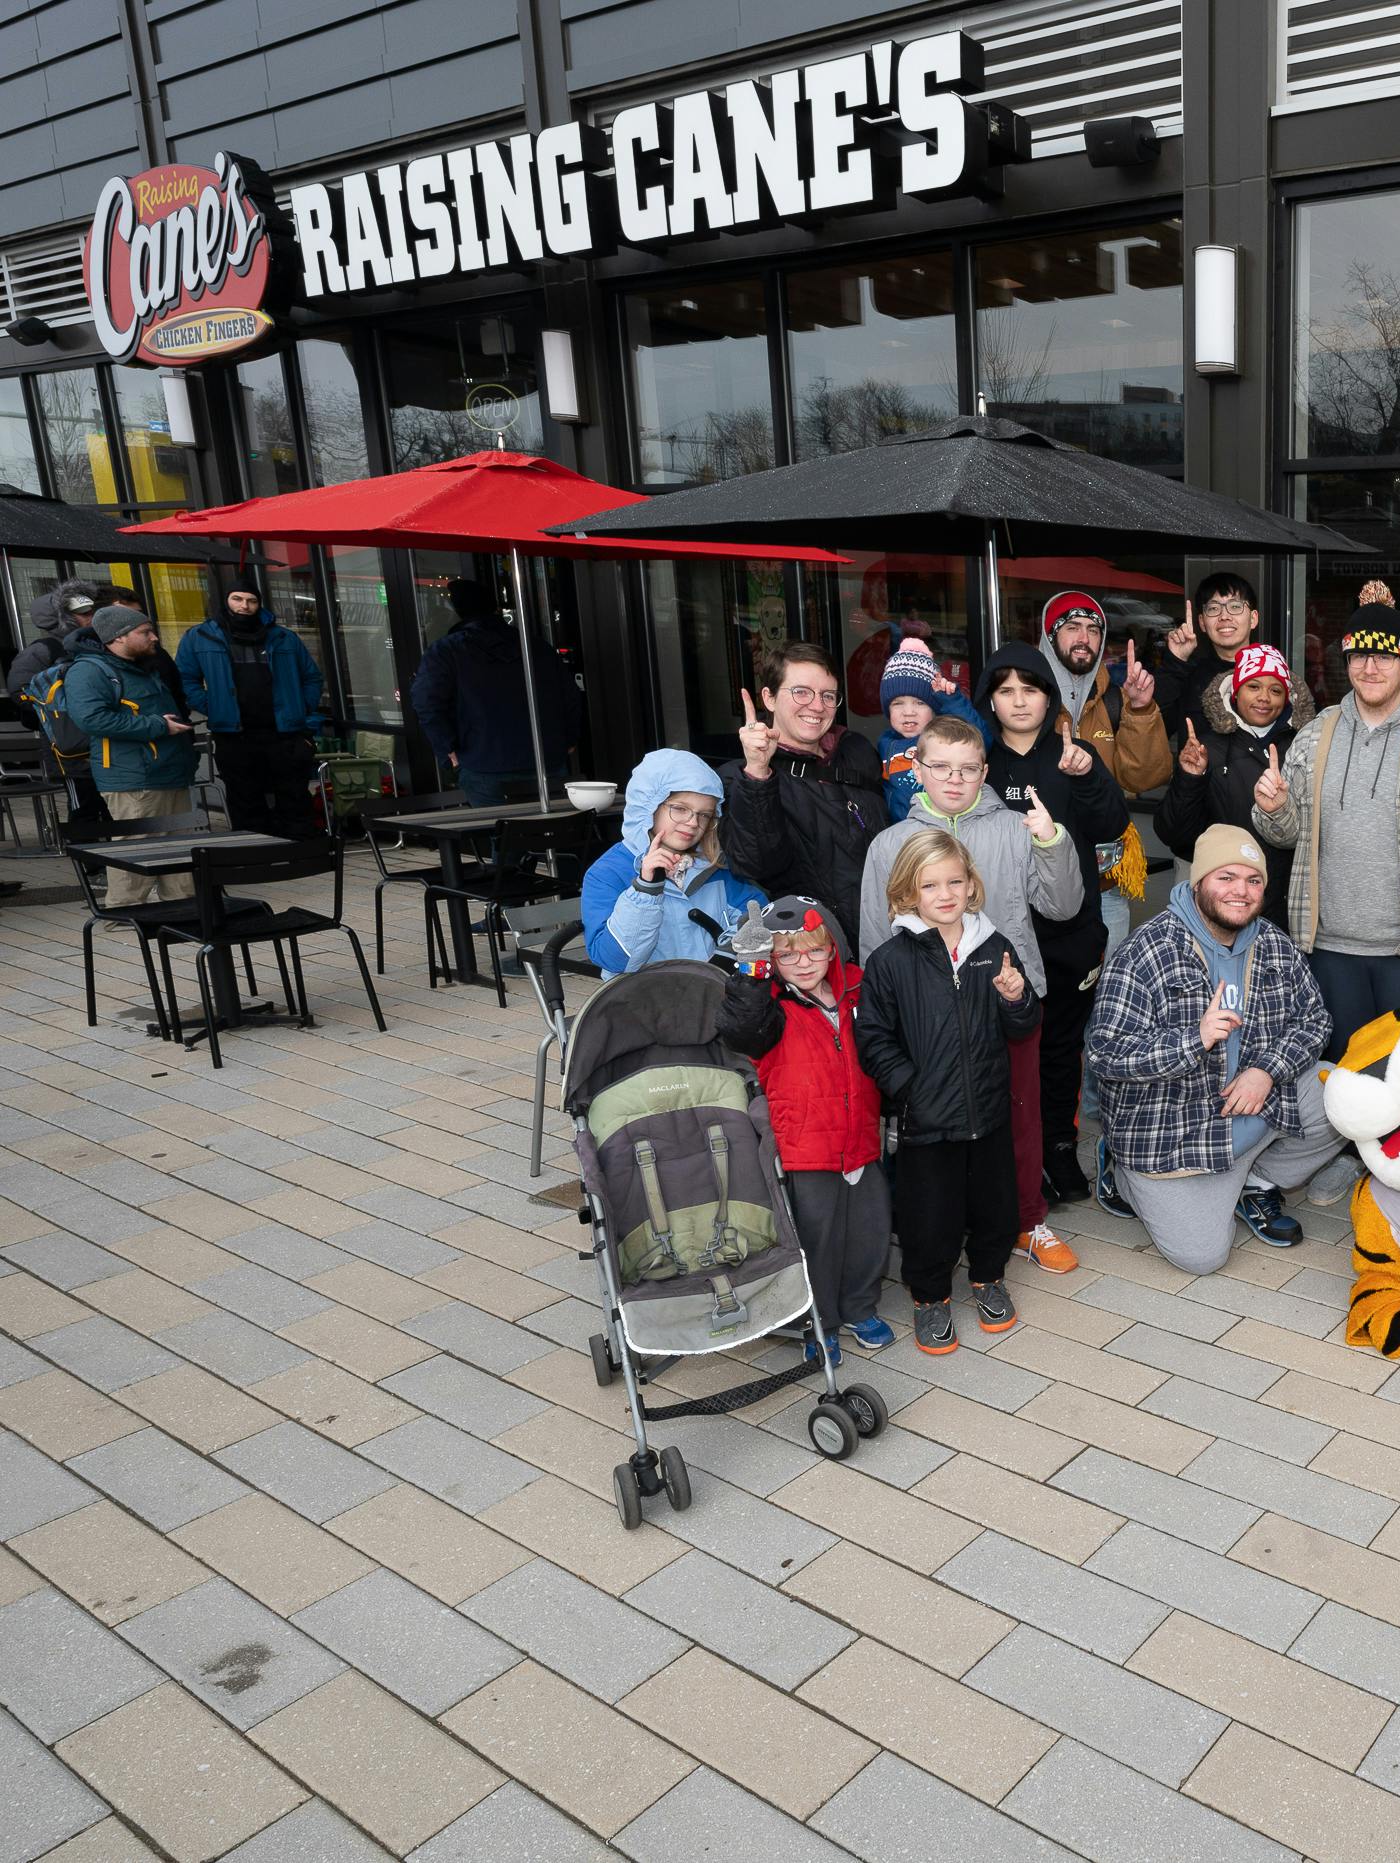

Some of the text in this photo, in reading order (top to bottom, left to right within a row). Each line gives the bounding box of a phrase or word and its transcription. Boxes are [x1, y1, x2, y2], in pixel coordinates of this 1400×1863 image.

[290, 30, 966, 298] RAISING CANE'S
[136, 170, 199, 218] Raising
[89, 151, 260, 357] Cane's
[155, 316, 256, 350] CHICKEN FINGERS
[471, 396, 513, 419] OPEN
[1334, 562, 1389, 574] TOWSON
[648, 1082, 690, 1093] MACLAREN
